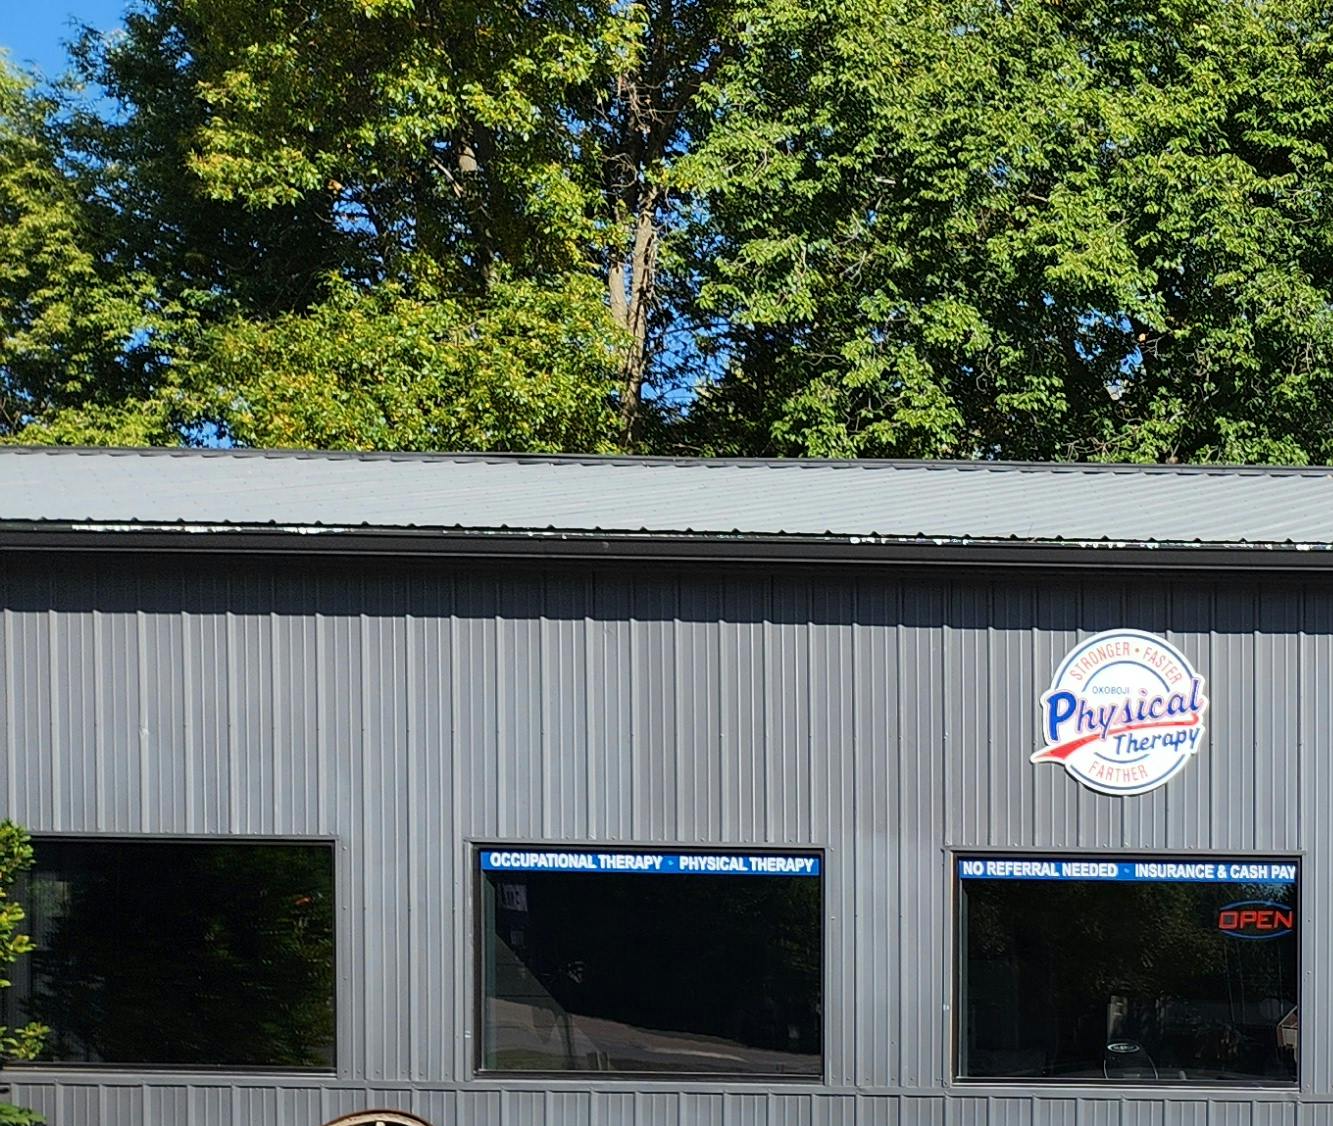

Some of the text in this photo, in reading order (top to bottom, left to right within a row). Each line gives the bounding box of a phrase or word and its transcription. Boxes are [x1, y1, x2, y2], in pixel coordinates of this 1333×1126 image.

[1070, 642, 1183, 684] STRONGER FASTER
[1092, 686, 1130, 694] OKOBOJI
[1047, 678, 1201, 741] Physical
[1114, 727, 1201, 755] Therapy
[1088, 761, 1149, 783] FARTHER
[489, 852, 814, 872] OCCUPATIONAL THERAPY PHYSICAL THERAPY
[963, 861, 1296, 880] NO REFERRAL NEEDED INSURANCE & CASH PAY
[1218, 910, 1294, 930] OPEN
